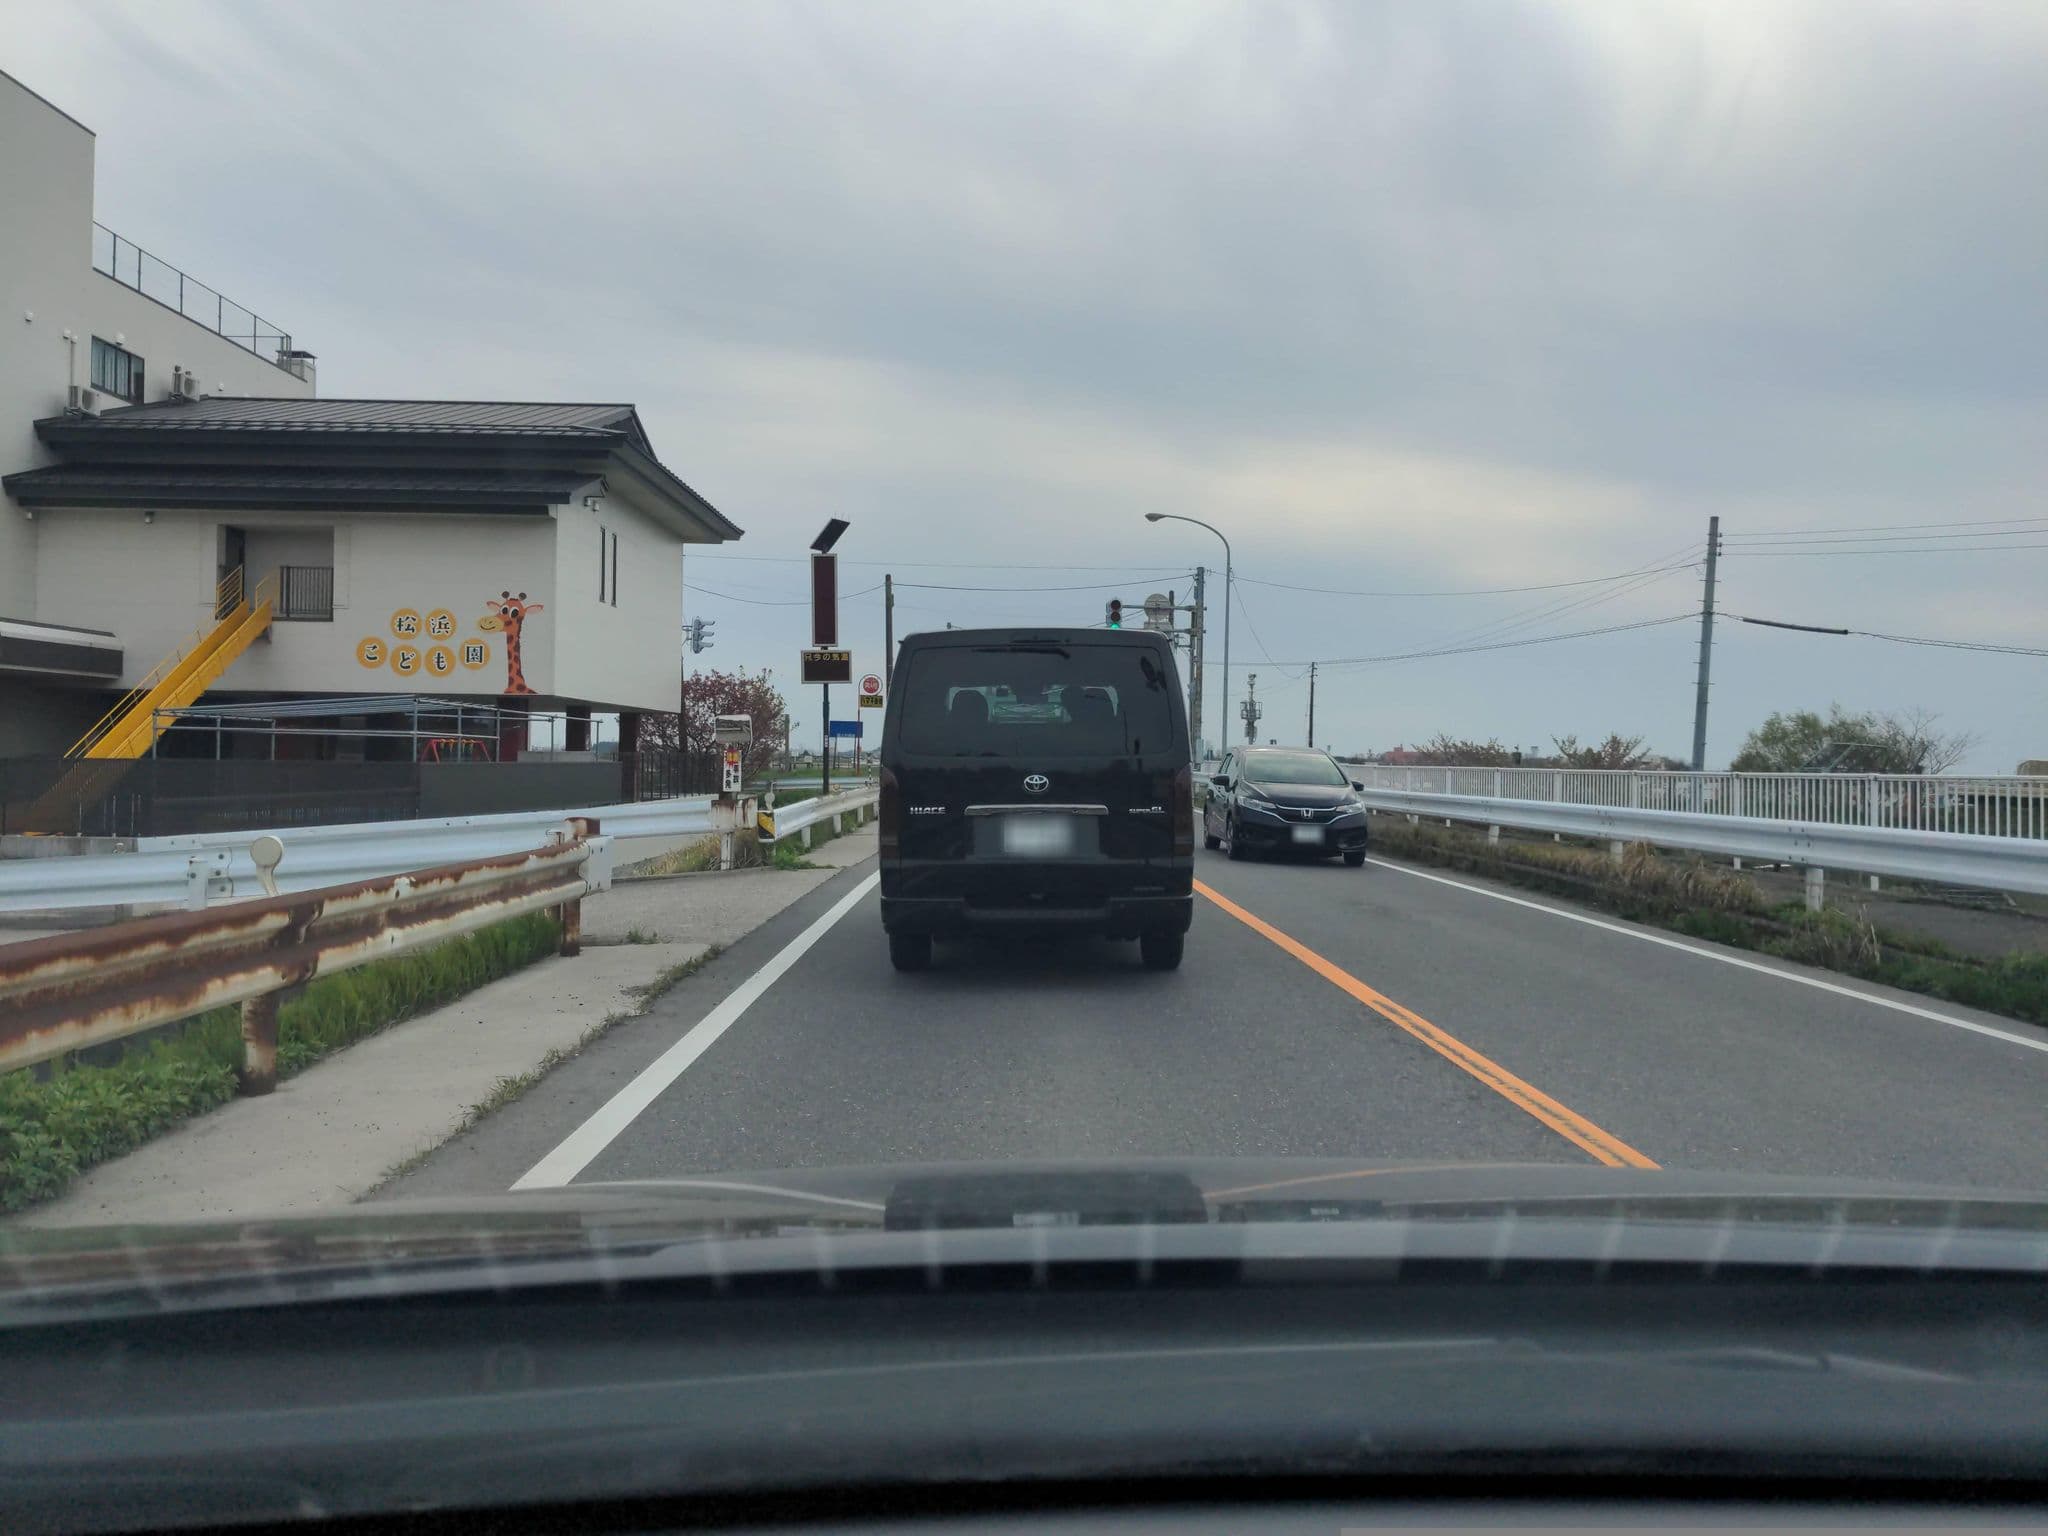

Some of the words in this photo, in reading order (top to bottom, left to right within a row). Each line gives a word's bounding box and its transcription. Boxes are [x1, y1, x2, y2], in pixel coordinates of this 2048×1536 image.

[396, 615, 451, 635] 松浜
[365, 645, 483, 671] こども園
[909, 806, 946, 815] HIACE
